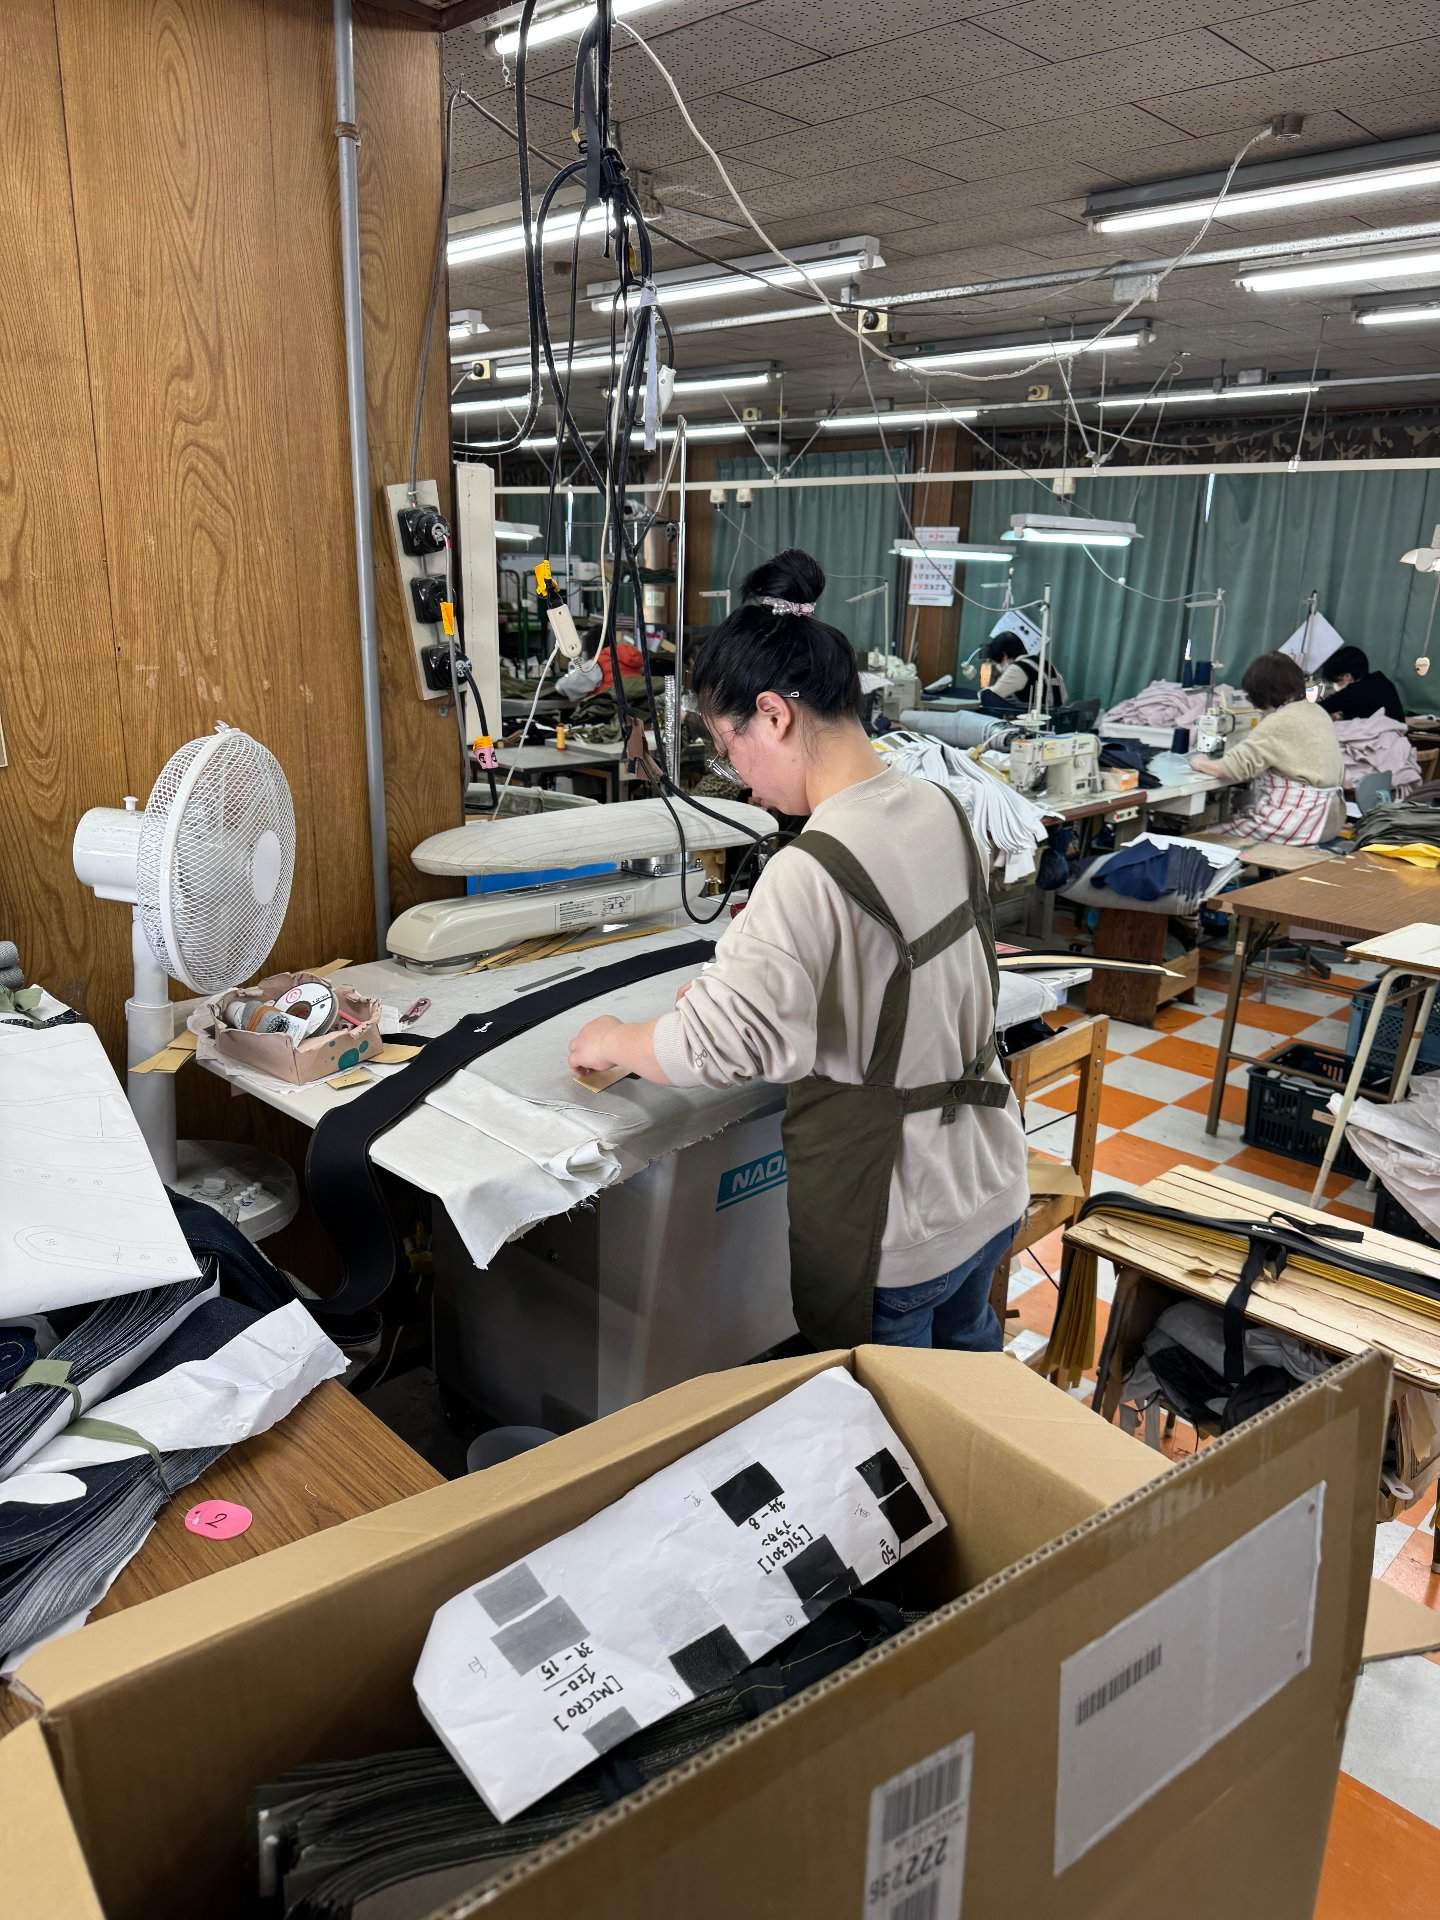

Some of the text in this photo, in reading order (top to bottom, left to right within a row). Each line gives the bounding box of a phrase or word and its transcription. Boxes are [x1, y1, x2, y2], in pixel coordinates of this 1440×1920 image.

[732, 1154, 786, 1193] NAO
[204, 1513, 228, 1529] 2
[881, 1544, 897, 1565] 50
